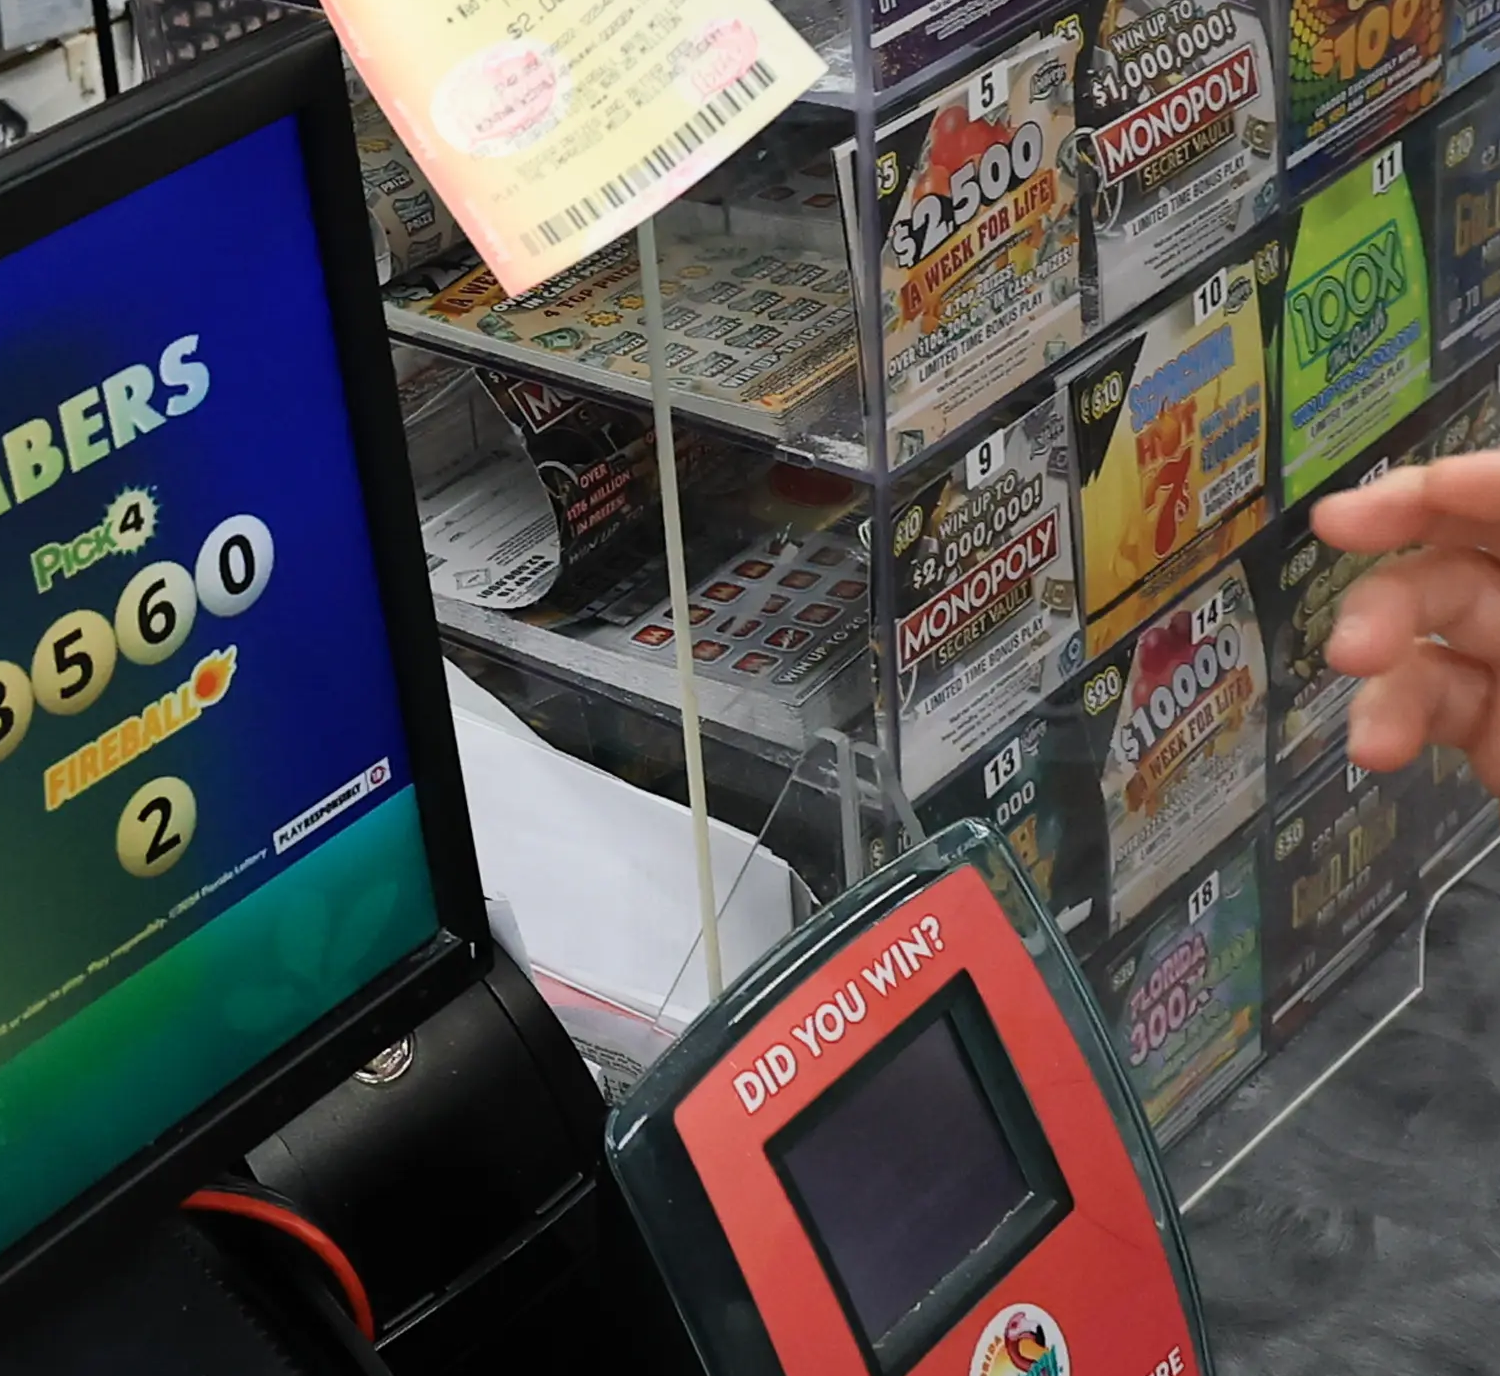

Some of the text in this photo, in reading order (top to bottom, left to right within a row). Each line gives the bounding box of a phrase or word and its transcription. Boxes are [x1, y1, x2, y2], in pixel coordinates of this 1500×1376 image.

[1092, 9, 1236, 108] $1,000,000!
[1111, 0, 1194, 55] WIN UP TO
[1102, 55, 1250, 173] MONOPOLY
[1143, 141, 1191, 186] SECRET
[891, 121, 1043, 269] $2,500
[925, 179, 1050, 292] WEEK FOR LIFE
[911, 480, 1045, 591] $2,000,000!
[50, 632, 96, 705] 5
[136, 578, 178, 647] 6
[218, 532, 258, 598] 0
[903, 528, 1054, 661] MONOPOLY
[44, 685, 199, 812] FIREBALL
[136, 794, 183, 866] 2
[731, 914, 948, 1115] DID YOU WIN?
